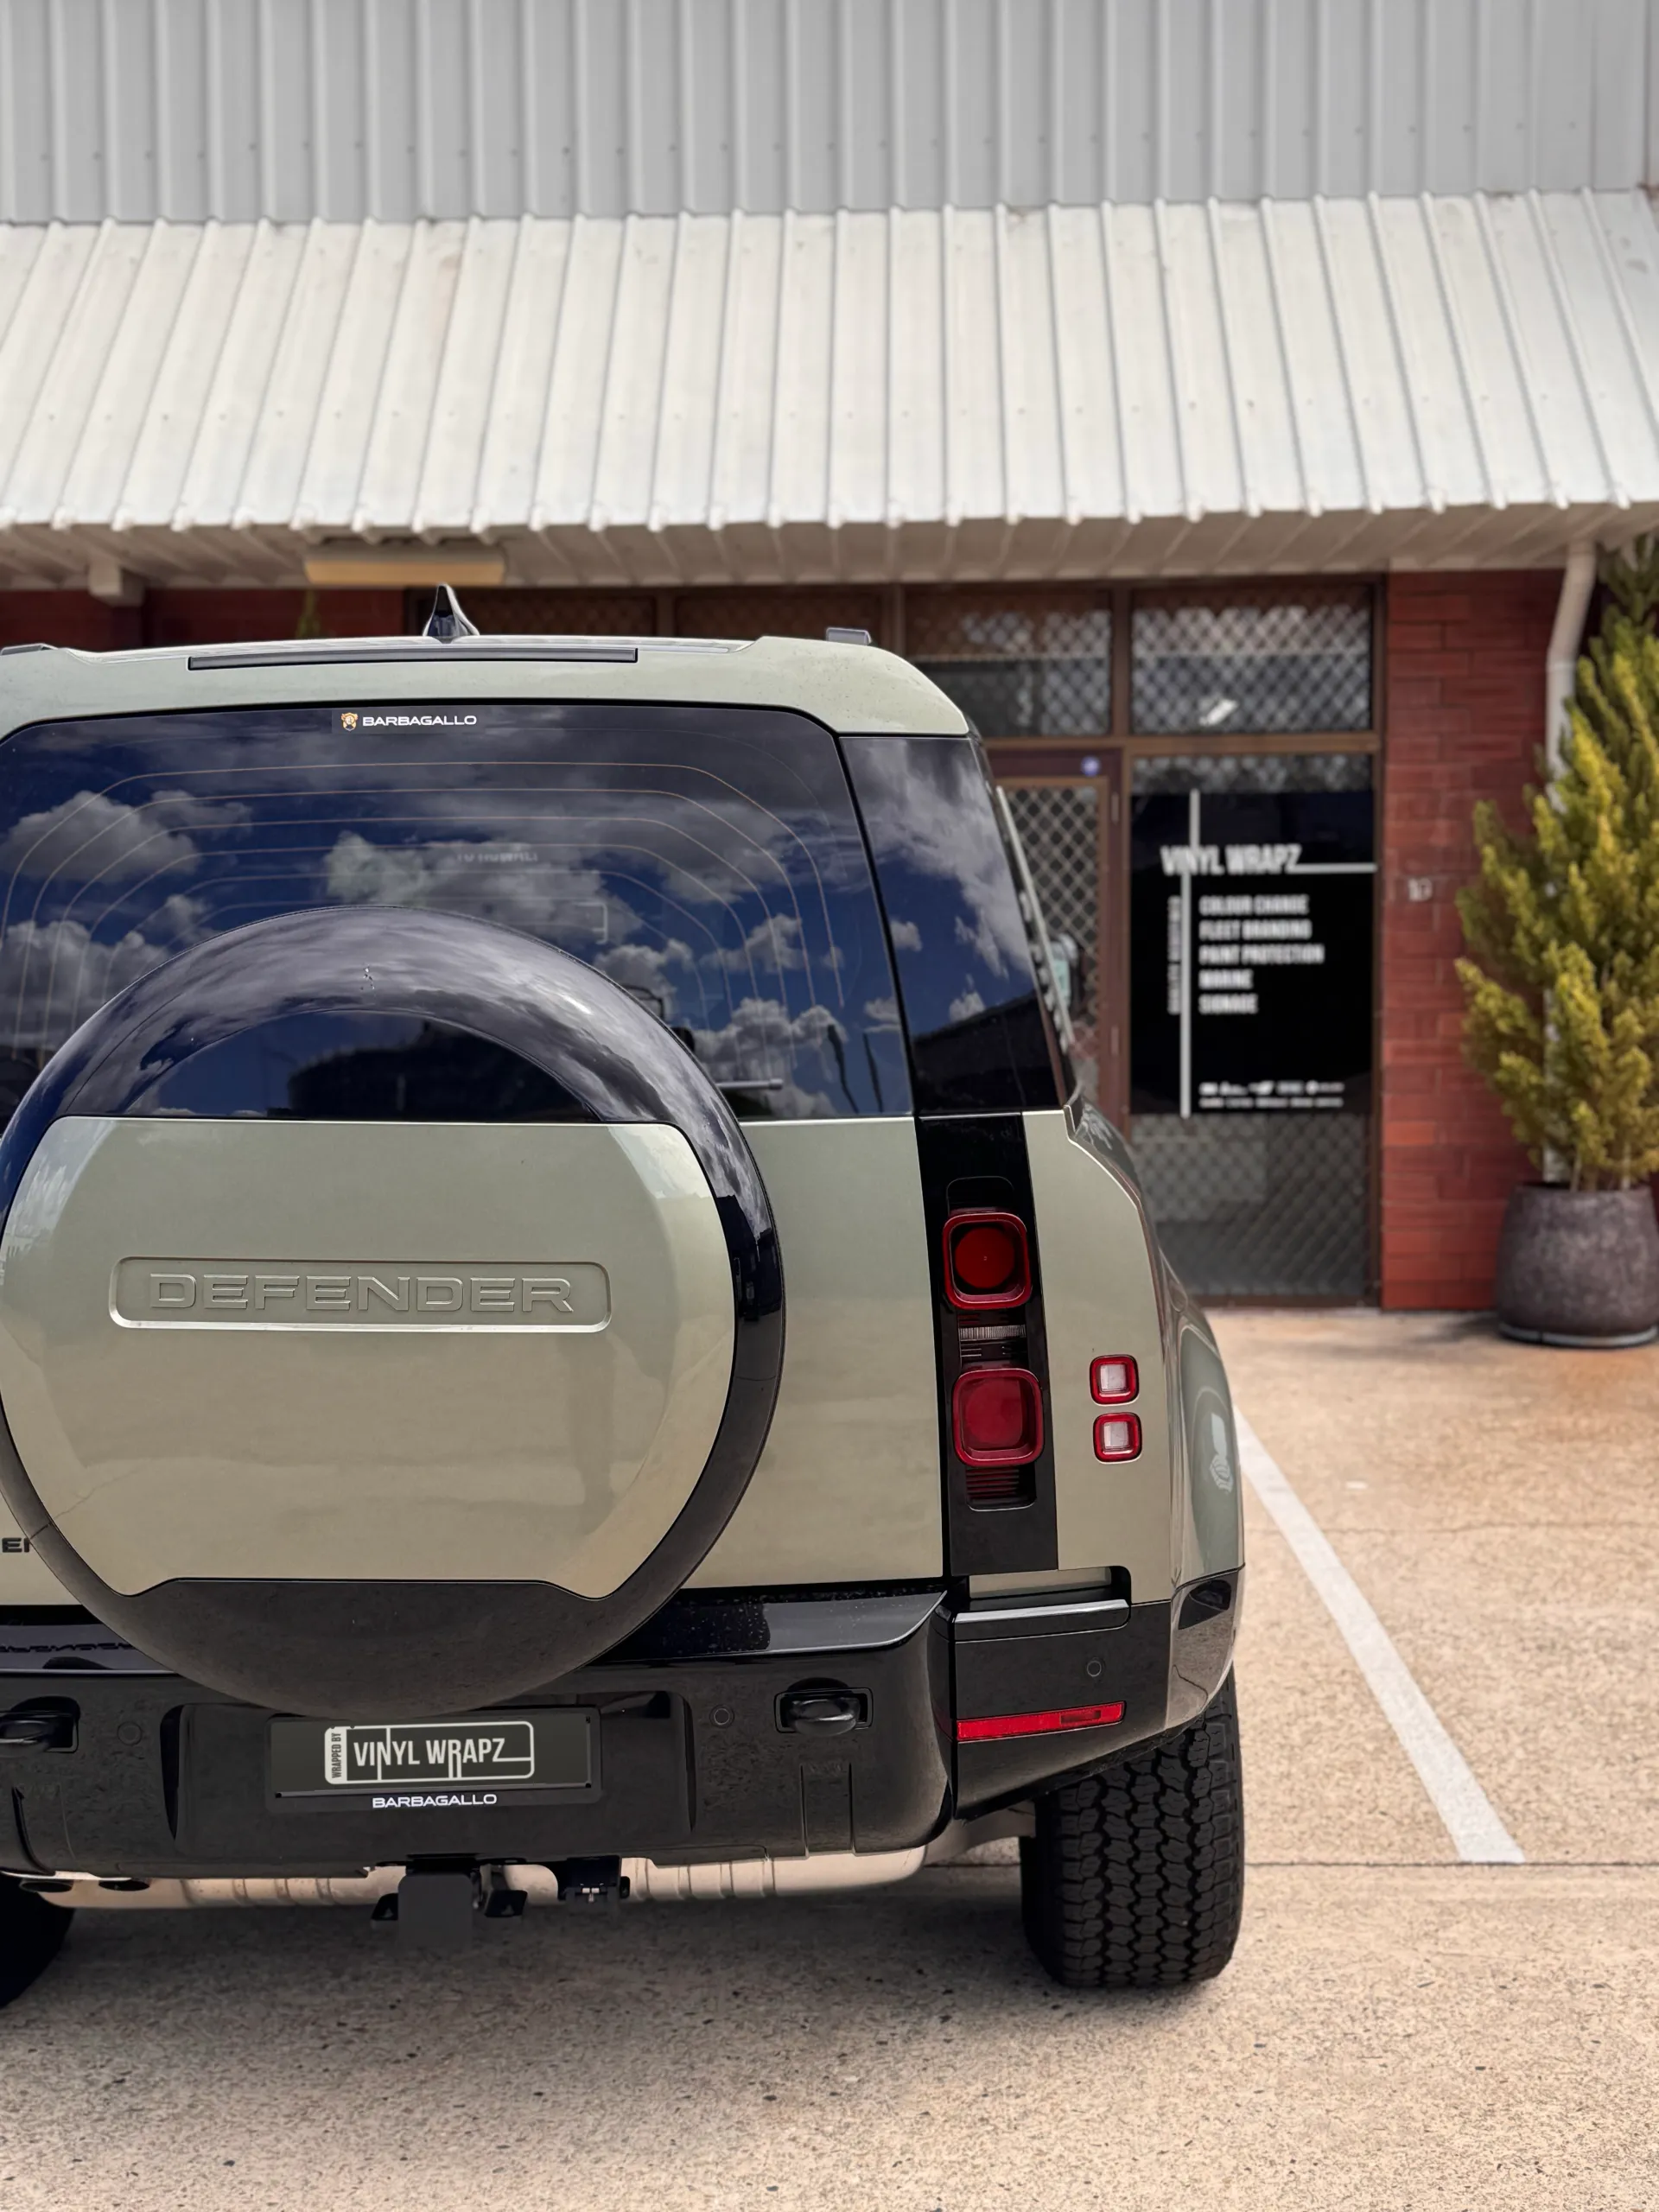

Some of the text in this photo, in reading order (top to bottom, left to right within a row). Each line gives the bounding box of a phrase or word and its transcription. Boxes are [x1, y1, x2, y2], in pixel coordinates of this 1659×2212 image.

[362, 715, 477, 727] BARBAGALLO
[1160, 843, 1303, 876] VINYL WRAPZ
[149, 1273, 573, 1313] DEFENDER
[331, 1732, 341, 1778] WRAPPED BY
[353, 1735, 508, 1771] VINYL WRAPZ
[372, 1794, 498, 1808] BARBAGALLO
